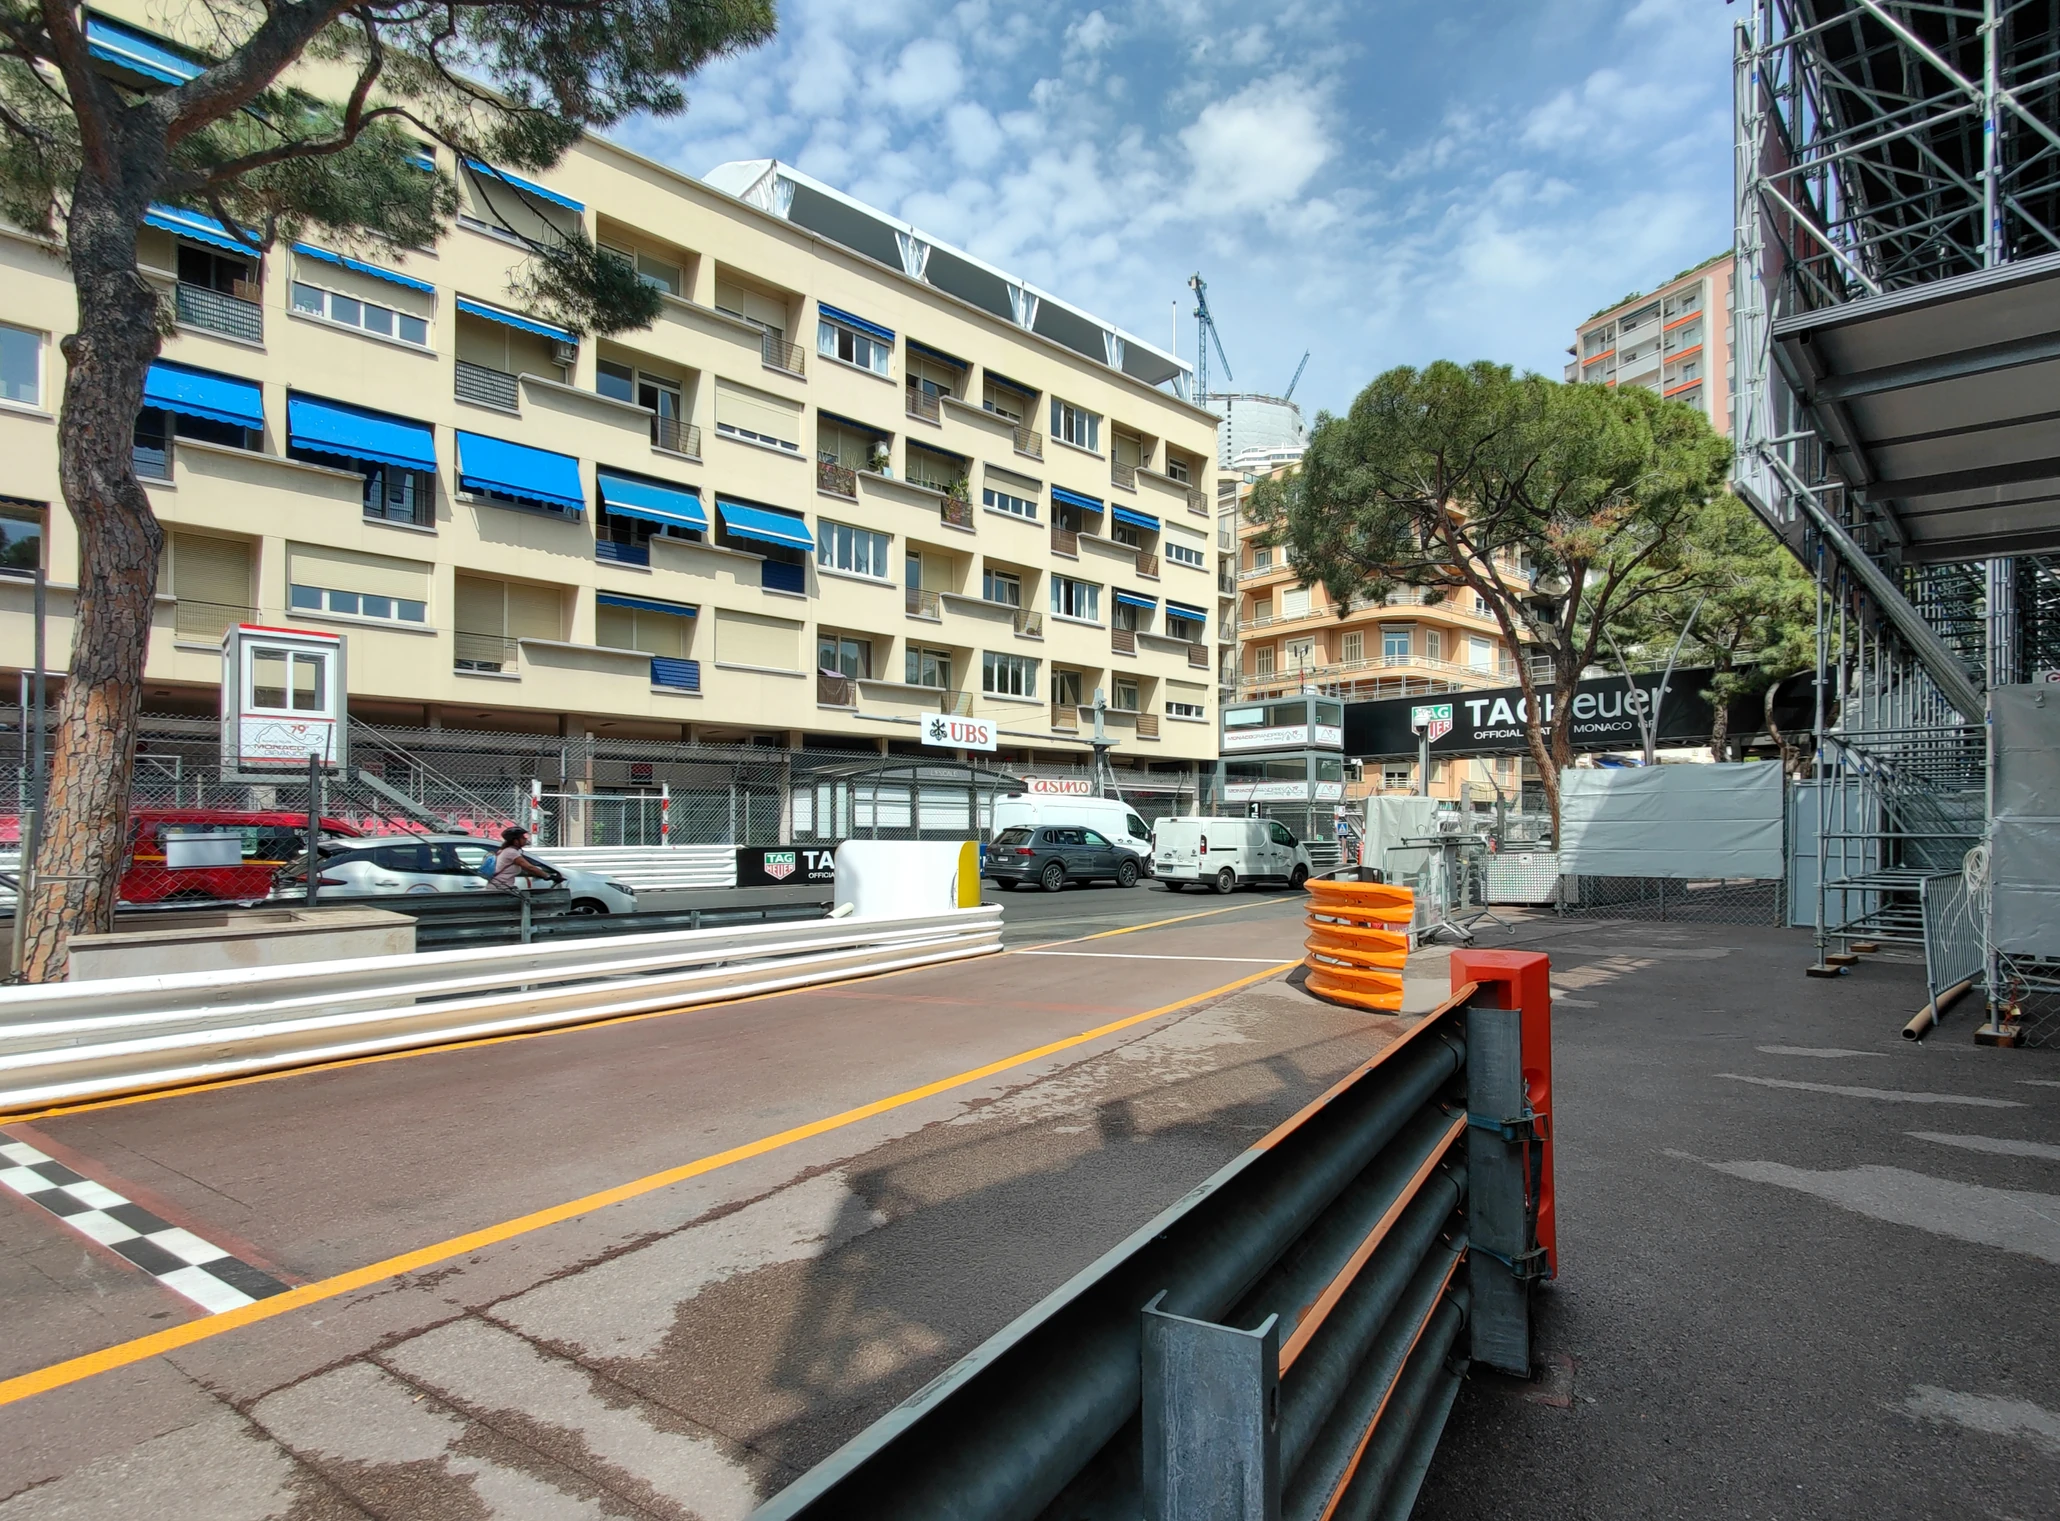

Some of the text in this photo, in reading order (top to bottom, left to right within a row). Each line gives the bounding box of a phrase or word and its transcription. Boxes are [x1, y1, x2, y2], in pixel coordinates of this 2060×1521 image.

[1415, 707, 1449, 719] AG
[950, 722, 988, 745] UBS
[1474, 729, 1524, 740] OFFICIAL
[1574, 721, 1633, 733] MONACO
[767, 853, 793, 863] TAG
[802, 850, 835, 870] TA
[766, 864, 793, 878] HEUER
